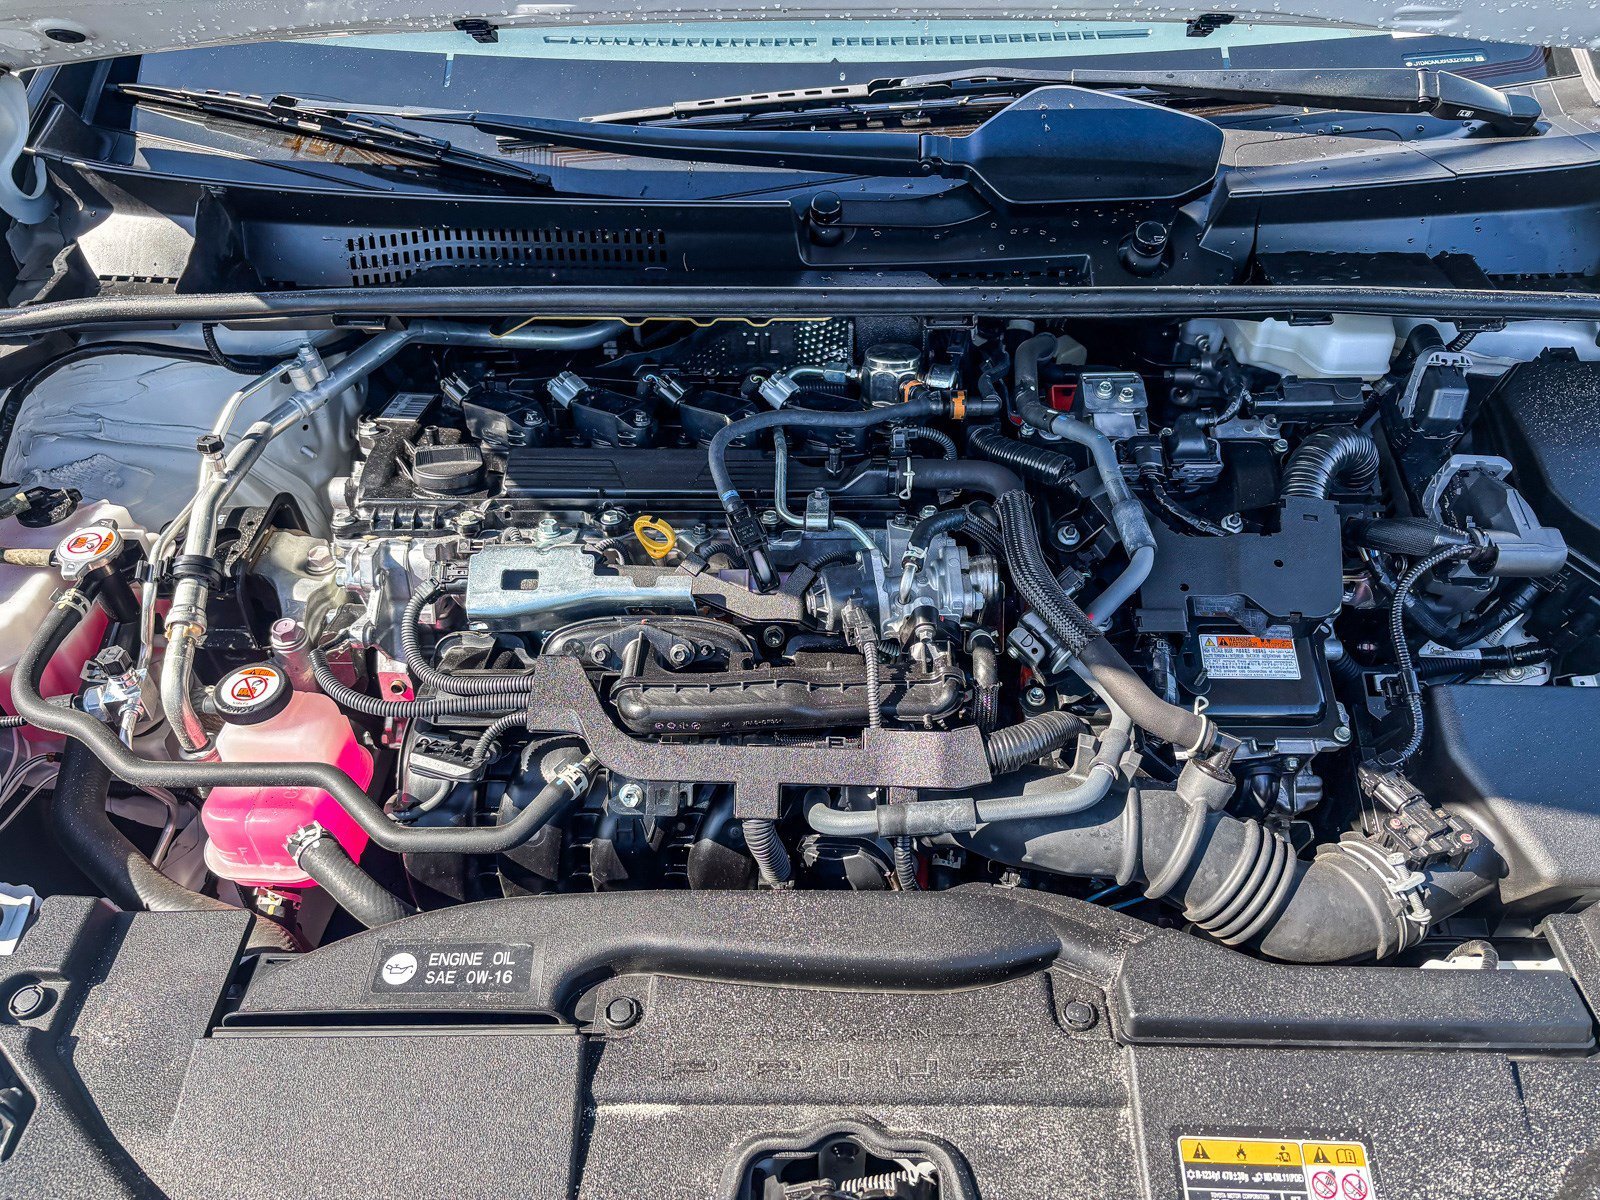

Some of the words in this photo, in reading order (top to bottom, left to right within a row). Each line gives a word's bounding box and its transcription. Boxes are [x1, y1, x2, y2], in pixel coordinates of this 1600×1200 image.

[428, 952, 484, 966] ENGINE
[492, 951, 516, 965] OIL
[425, 971, 456, 984] SAE
[466, 970, 513, 984] 0W-16
[662, 1057, 1026, 1081] PRIUS
